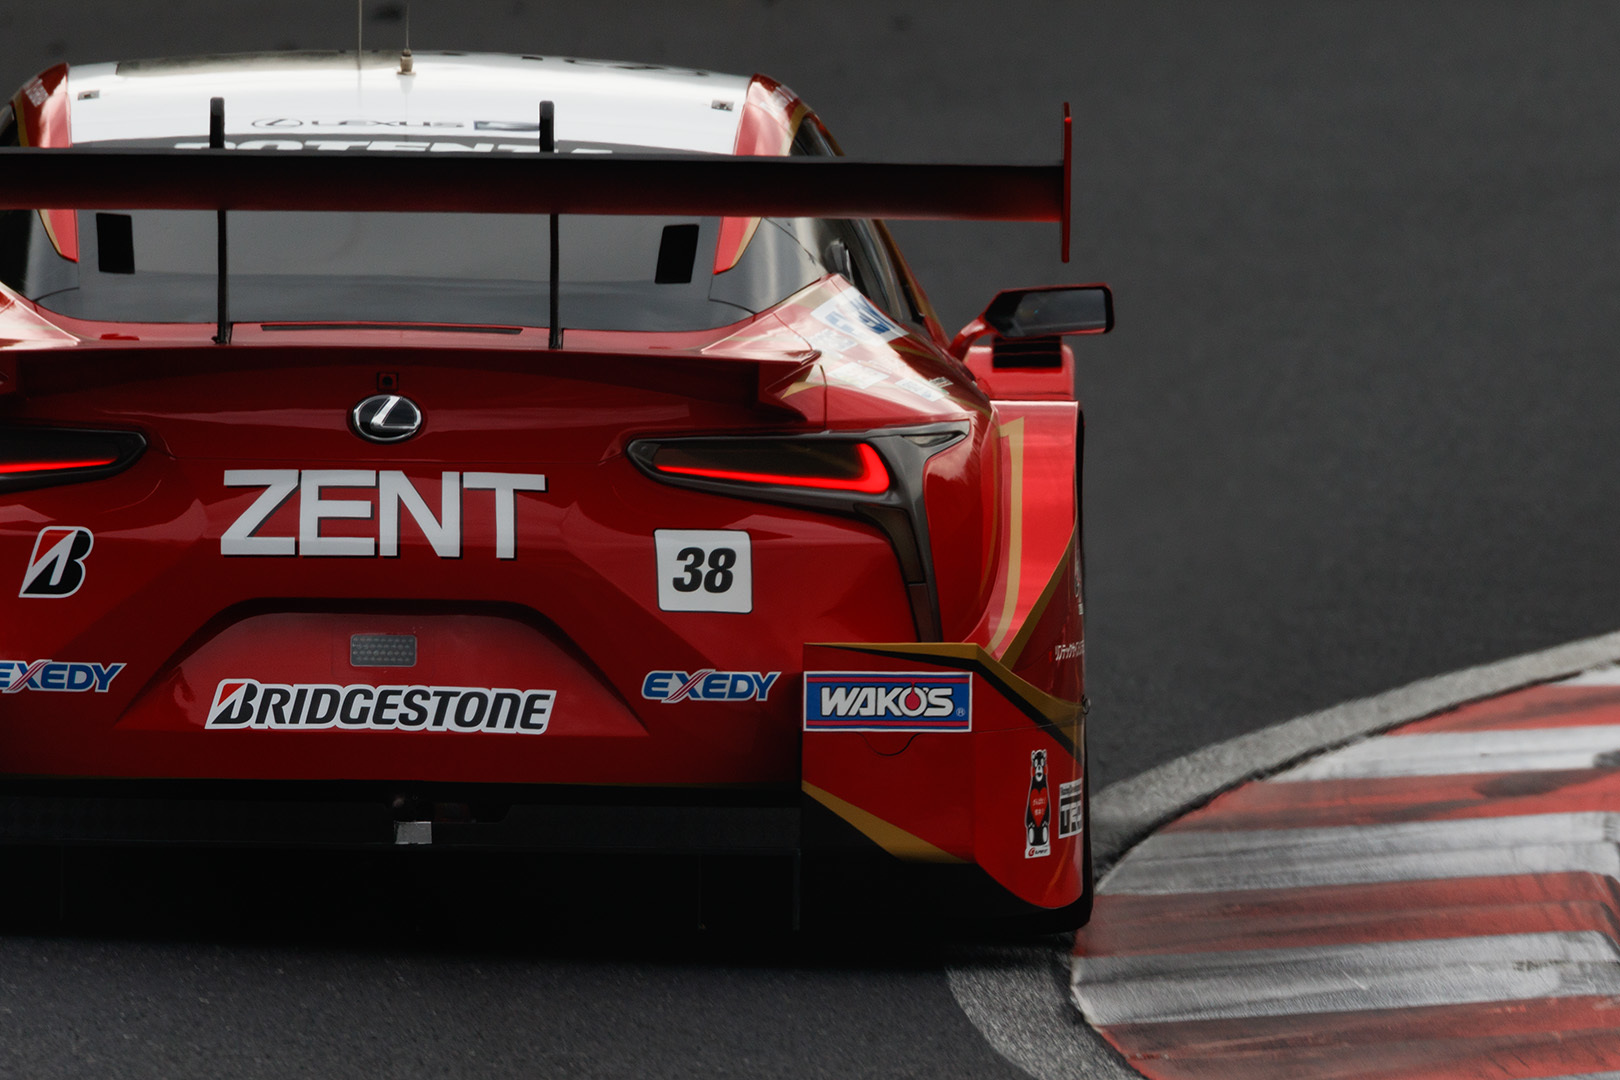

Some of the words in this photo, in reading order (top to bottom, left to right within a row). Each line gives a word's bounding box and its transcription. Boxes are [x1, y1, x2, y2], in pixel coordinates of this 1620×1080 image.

[220, 469, 546, 559] ZENT
[672, 547, 737, 593] 38
[0, 660, 126, 692] EXEDY
[642, 669, 781, 702] EXEDY
[206, 679, 555, 734] BRIDGESTONE
[821, 687, 954, 717] WAKO'S
